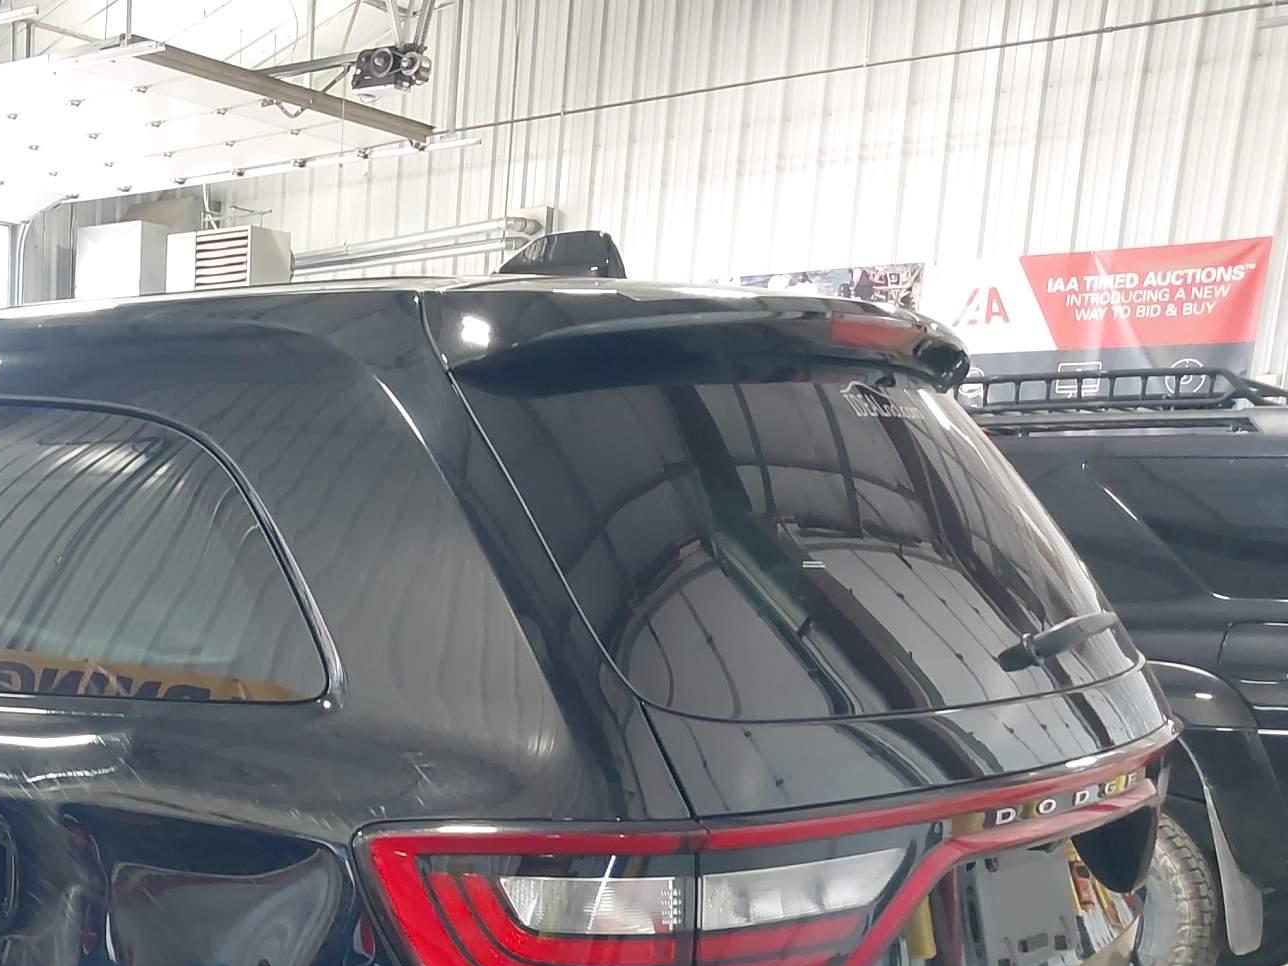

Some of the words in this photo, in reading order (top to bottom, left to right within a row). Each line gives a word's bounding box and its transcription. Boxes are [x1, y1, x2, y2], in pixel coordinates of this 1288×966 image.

[1047, 276, 1080, 294] IAA
[1083, 273, 1139, 291] TIMED
[1065, 288, 1171, 307] INTRODUCING
[1174, 288, 1187, 301] A
[1191, 284, 1232, 300] NEW
[1074, 307, 1107, 321] WAY
[1111, 305, 1131, 320] TO
[1135, 303, 1162, 318] BID
[1165, 303, 1178, 317] &
[1182, 300, 1218, 316] BUY
[995, 772, 1138, 825] DODGE
